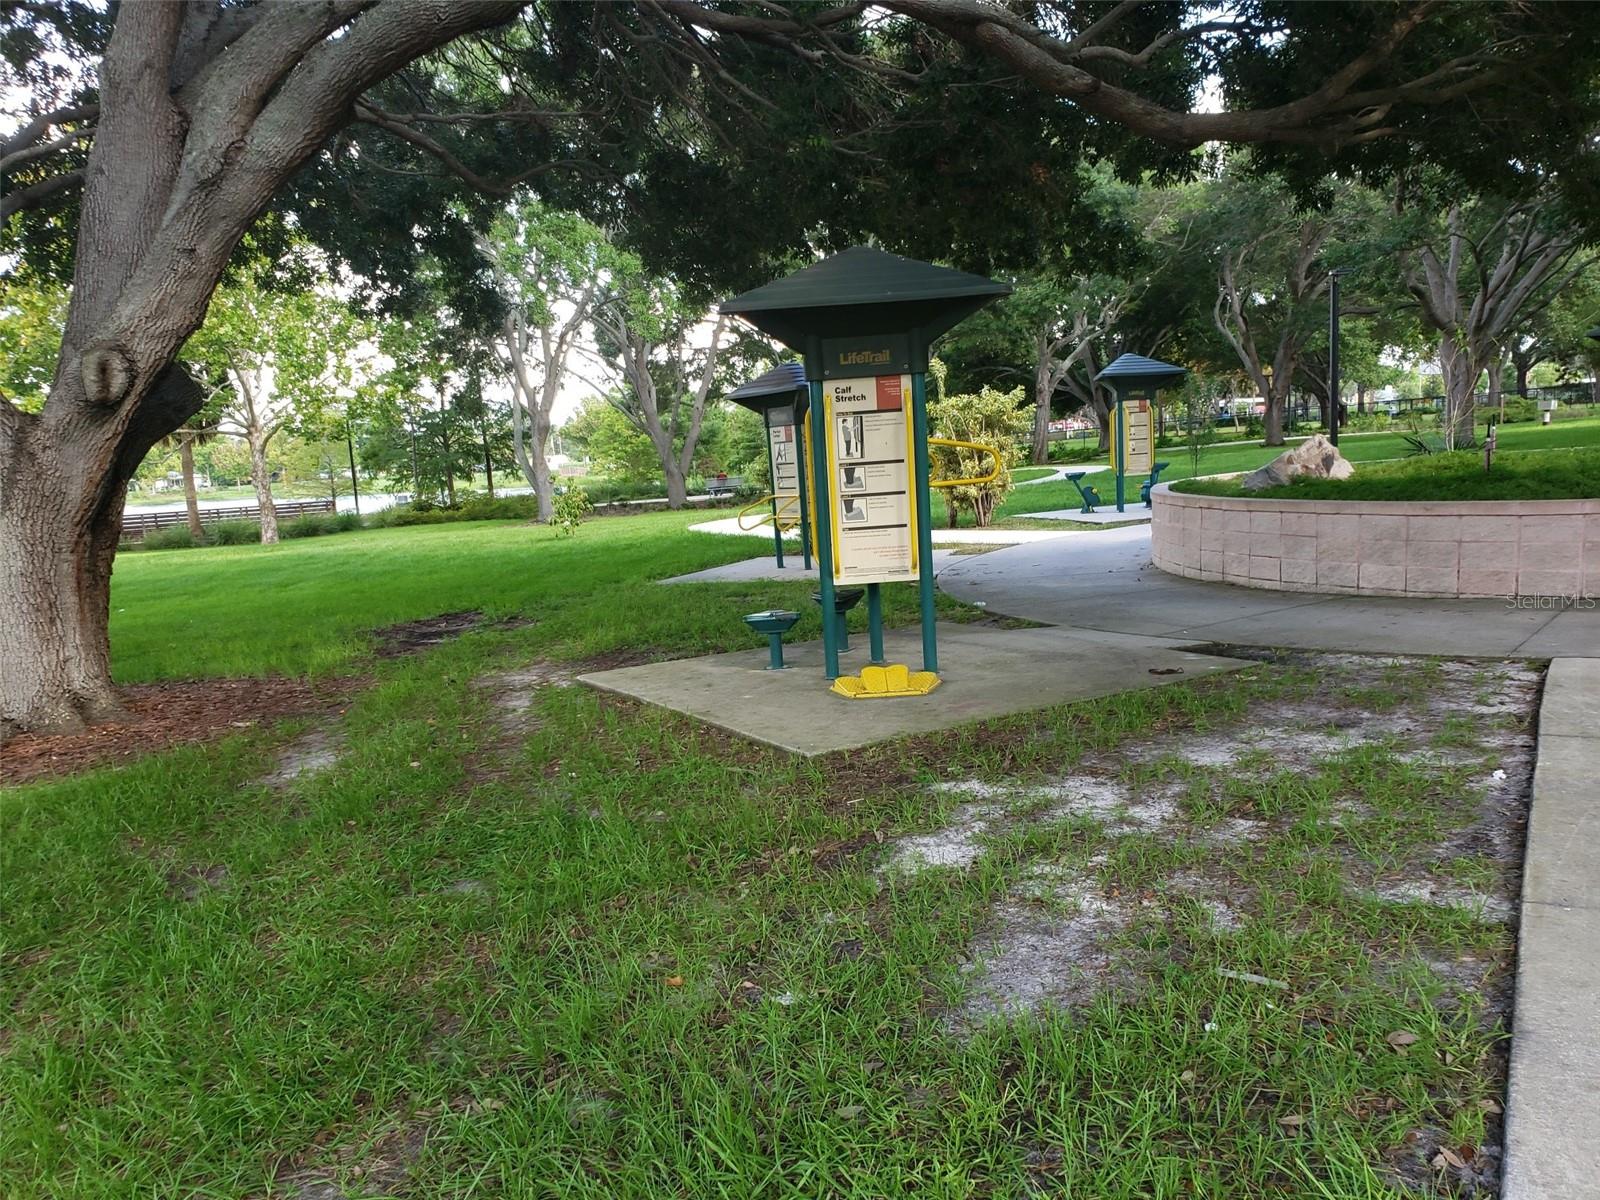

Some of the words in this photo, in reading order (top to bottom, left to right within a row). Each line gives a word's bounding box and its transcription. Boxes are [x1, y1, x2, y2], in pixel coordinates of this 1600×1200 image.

[840, 350, 890, 365] LifeTrail
[834, 386, 852, 394] Calf
[835, 394, 867, 402] Stretch
